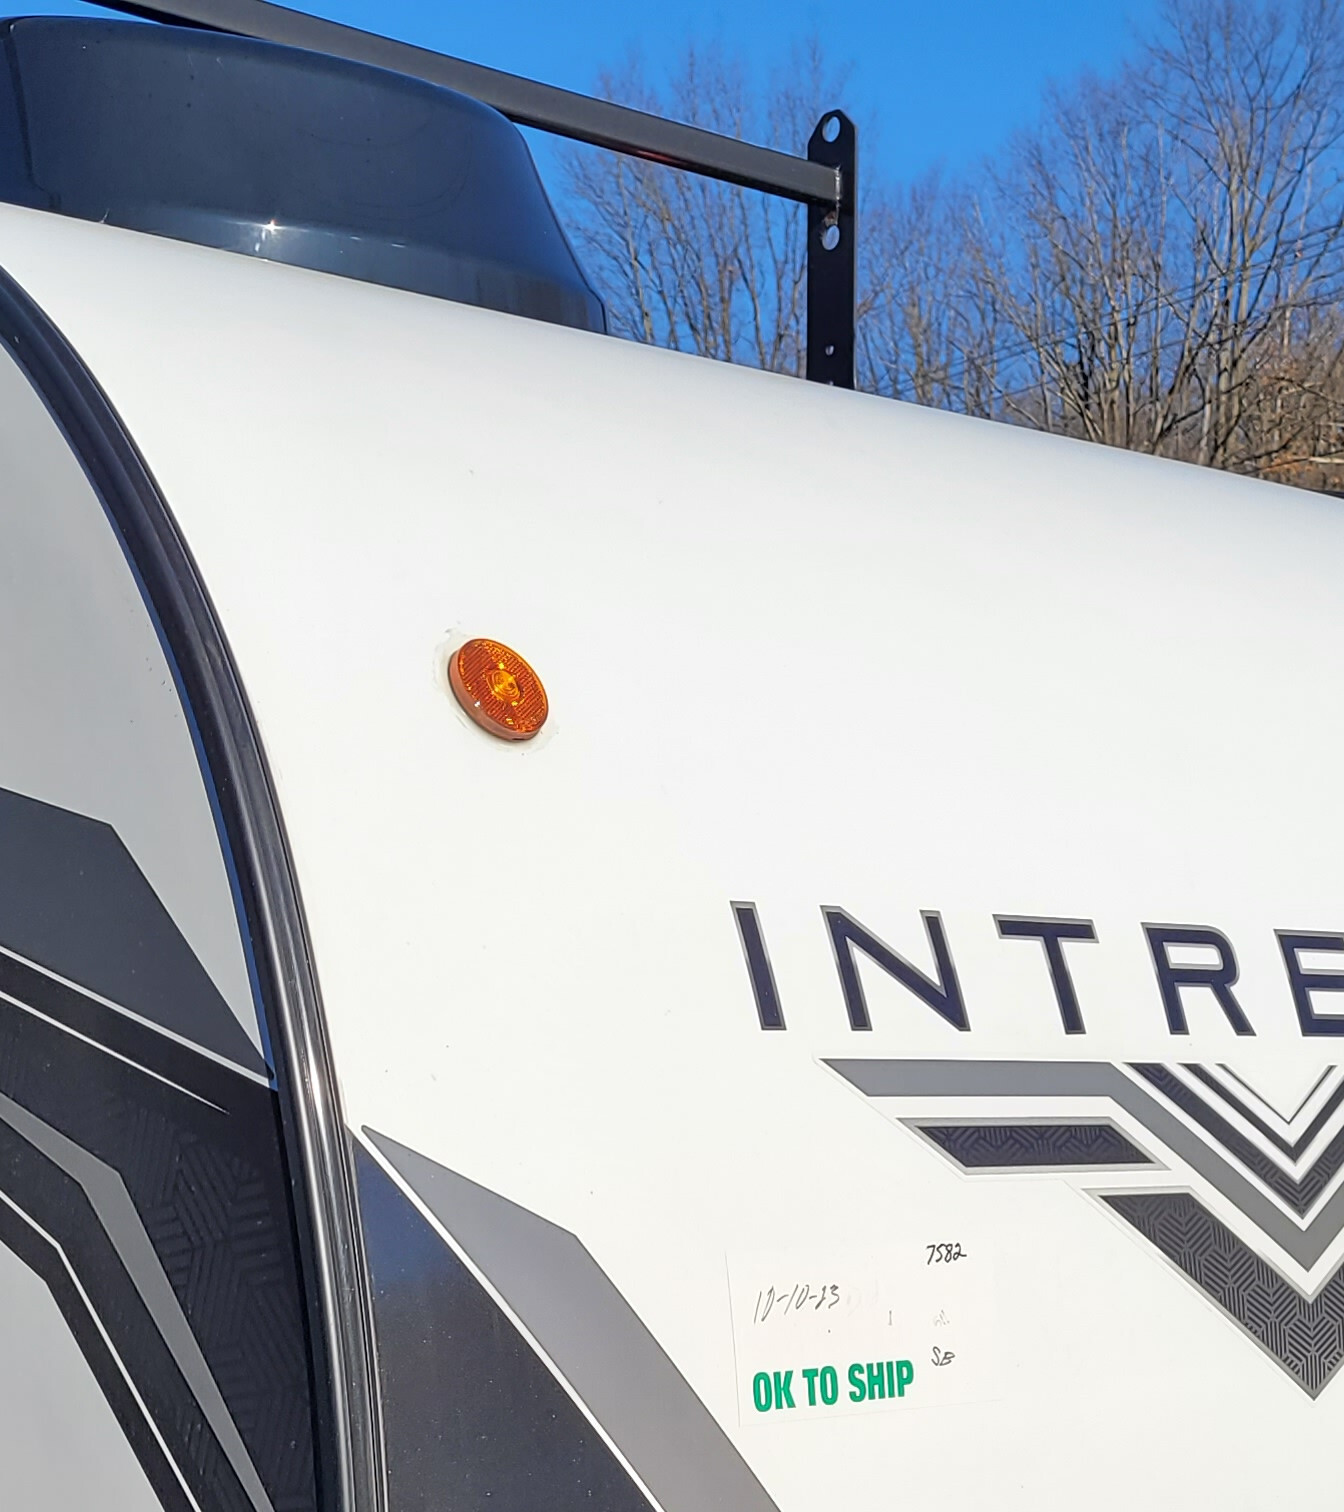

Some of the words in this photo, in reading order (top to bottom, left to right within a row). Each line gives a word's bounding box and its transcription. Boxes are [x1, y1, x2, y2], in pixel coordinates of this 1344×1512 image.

[926, 1243, 967, 1265] 7582
[752, 1370, 796, 1412] OK
[802, 1365, 838, 1406] TO
[848, 1359, 914, 1402] SHIP
